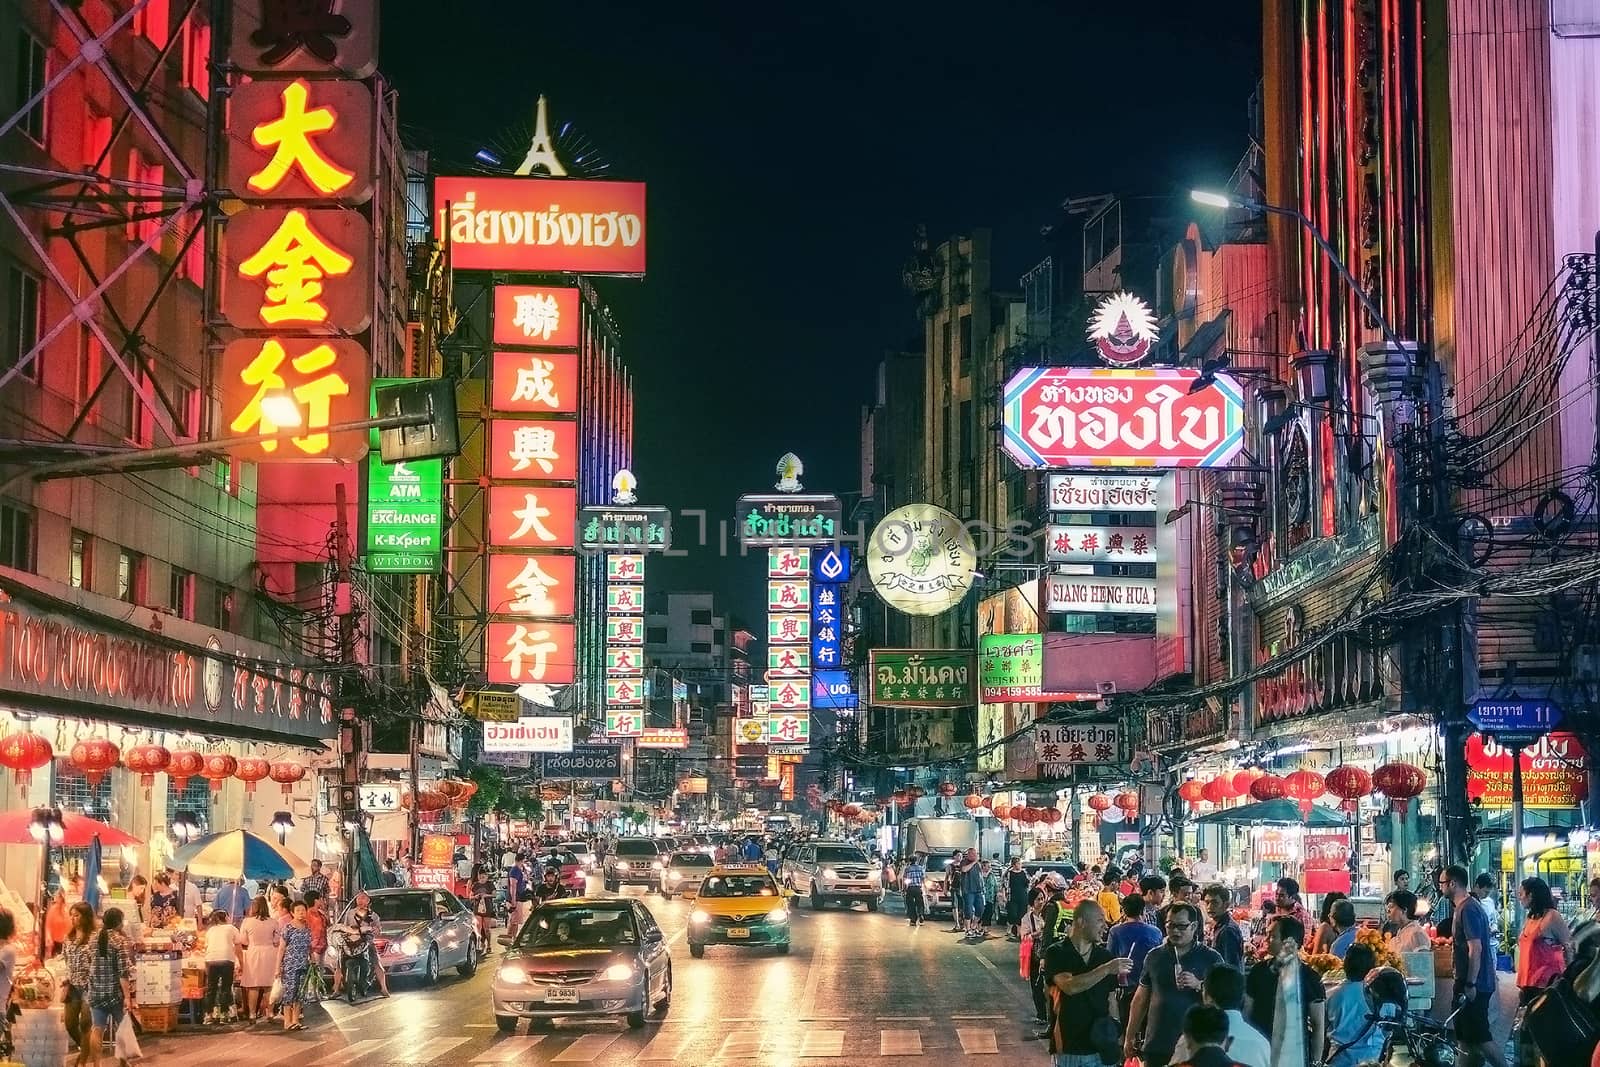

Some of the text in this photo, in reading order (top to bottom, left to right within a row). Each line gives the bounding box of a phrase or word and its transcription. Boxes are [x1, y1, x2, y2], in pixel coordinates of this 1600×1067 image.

[1040, 379, 1133, 404] ห้างทอง
[389, 484, 421, 497] ATM
[502, 293, 561, 681] 聯成興大金行
[372, 514, 437, 525] EXCHANGE
[374, 533, 431, 548] K-Expert
[1053, 533, 1157, 556] 林祥興藥
[374, 557, 434, 566] WISDOM
[1053, 584, 1089, 602] SIANG
[1090, 585, 1123, 604] HENG
[1126, 587, 1150, 605] HUA
[817, 589, 836, 663] 盤谷銀行
[616, 558, 636, 732] 和成興大金行
[778, 553, 801, 739] 和成興大金行
[830, 685, 850, 695] UO
[1478, 705, 1523, 716] เยาวราช
